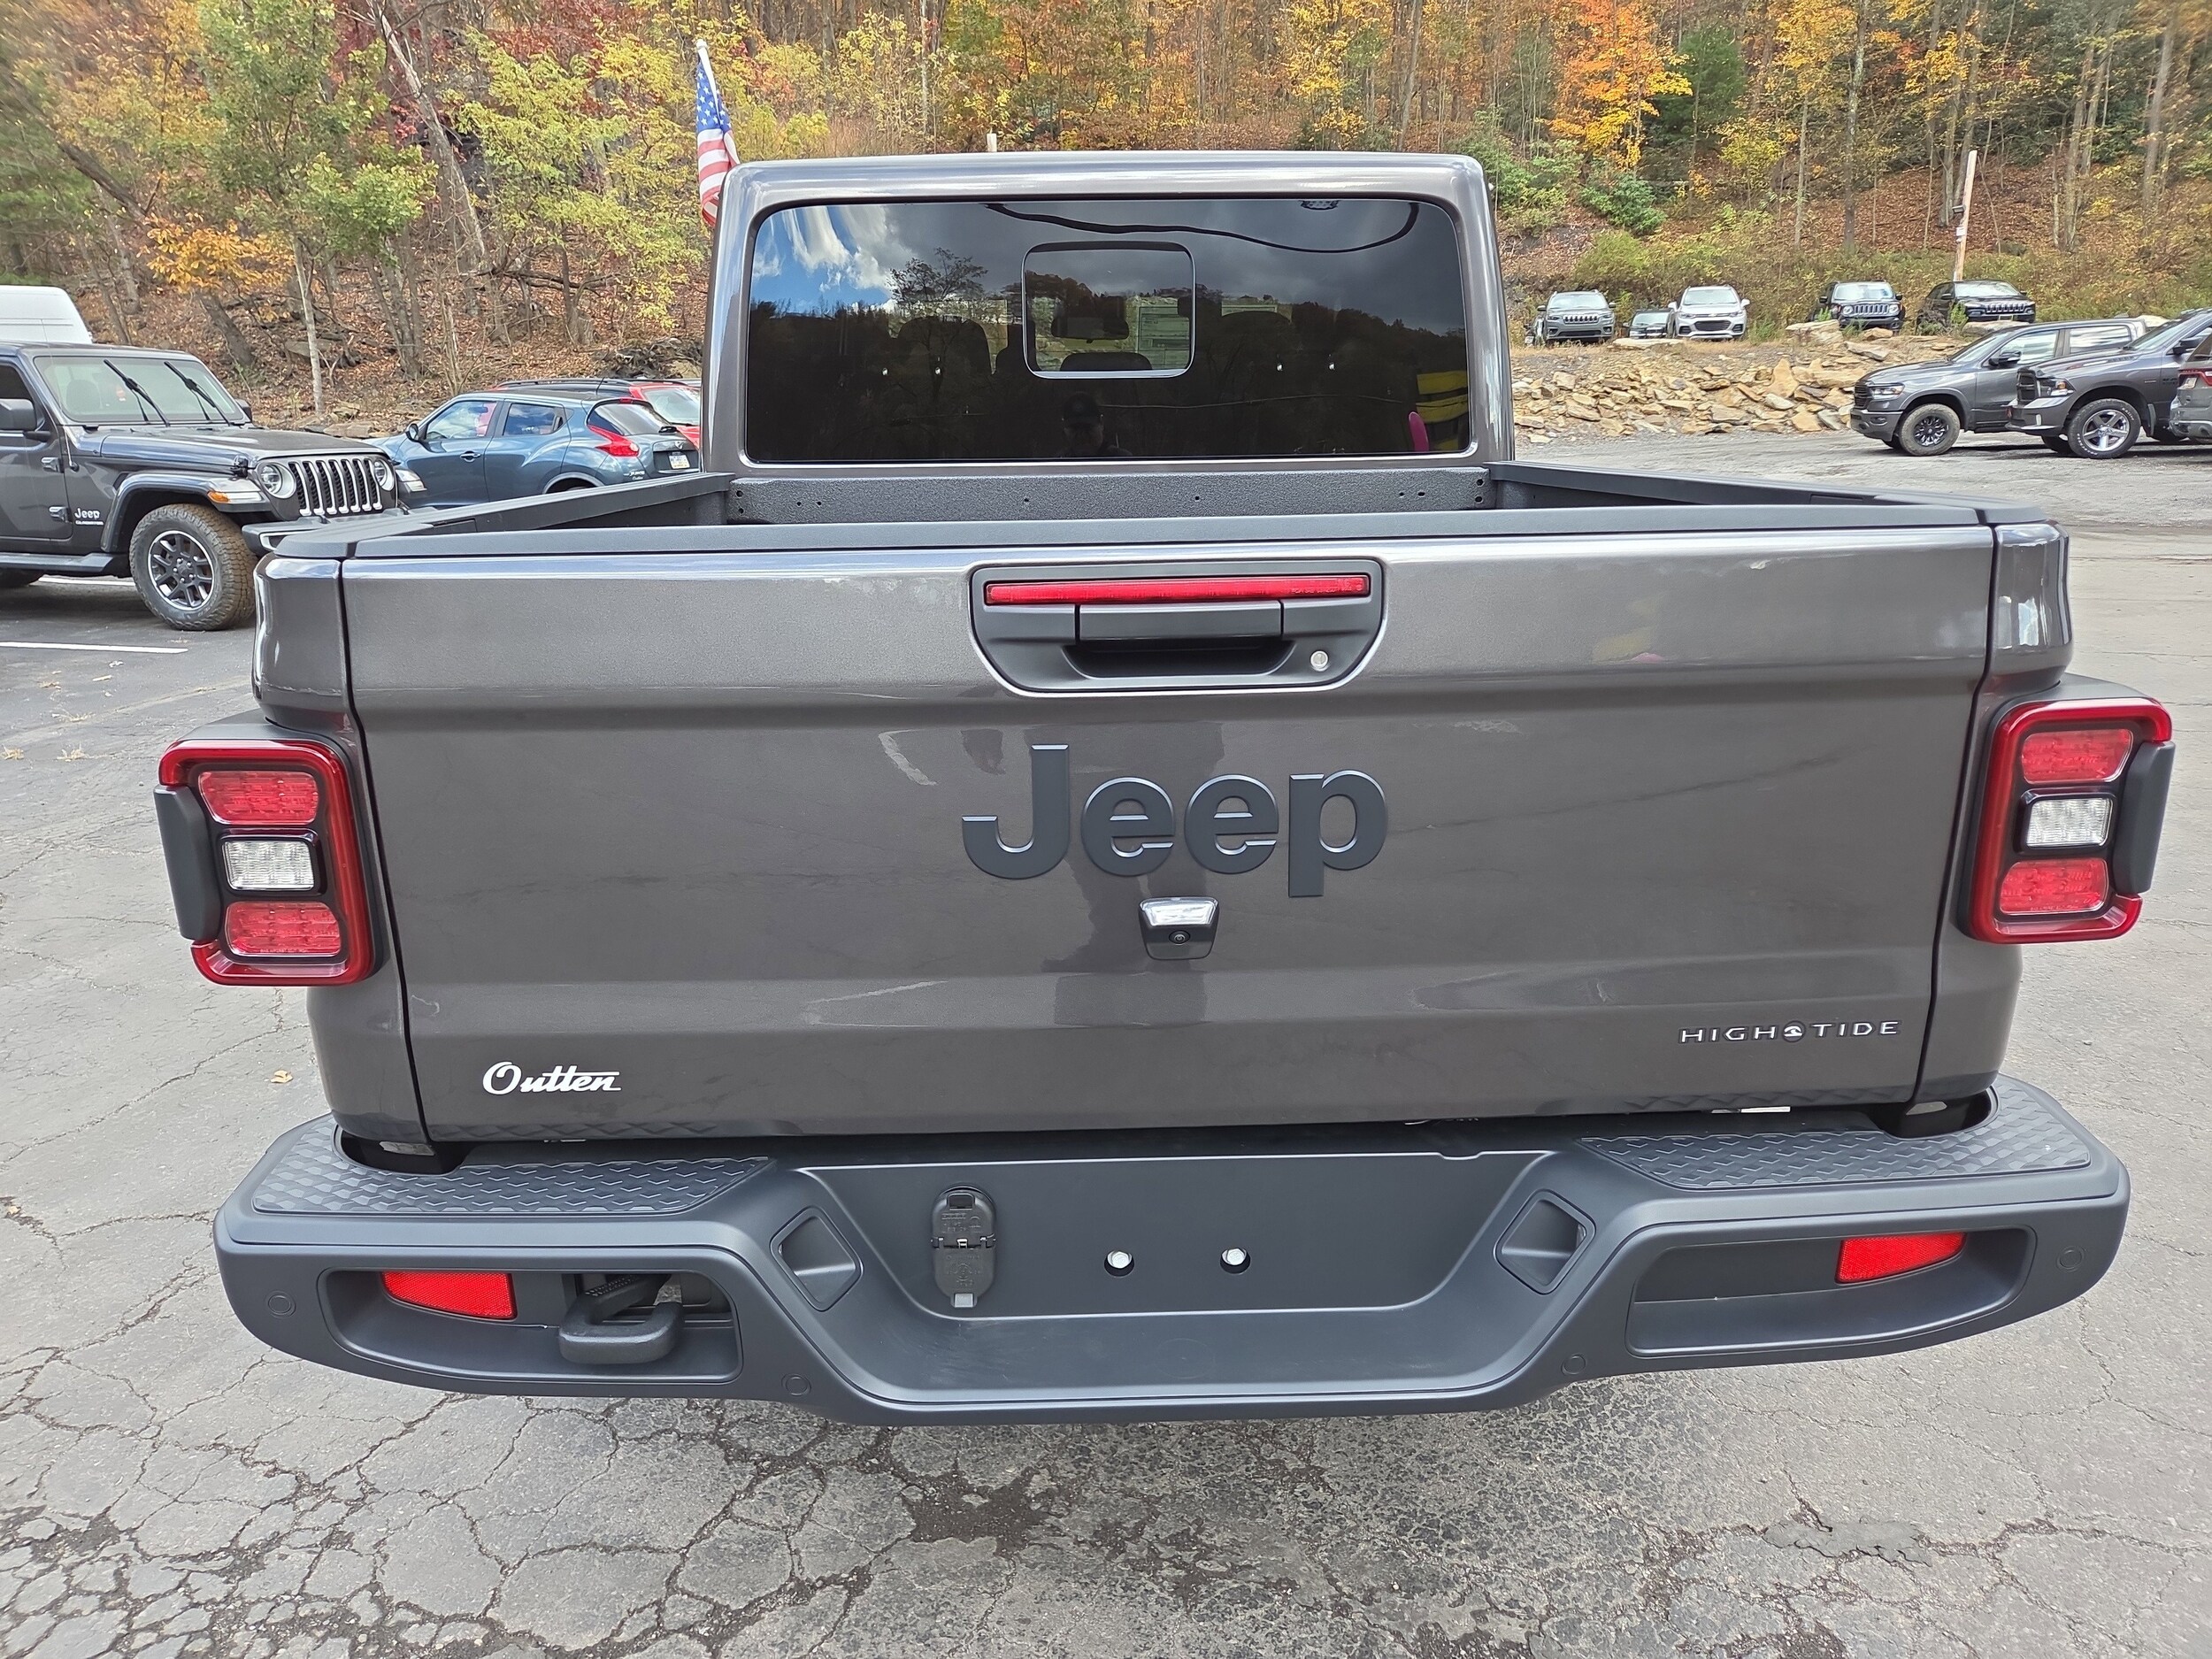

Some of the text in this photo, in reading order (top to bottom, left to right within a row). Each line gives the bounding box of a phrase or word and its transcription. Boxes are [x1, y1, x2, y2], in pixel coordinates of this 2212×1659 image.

[74, 507, 100, 520] Jeep
[961, 743, 1388, 897] Jeep
[1679, 1020, 1901, 1043] HIGH TIDE
[482, 1061, 622, 1095] Outten
